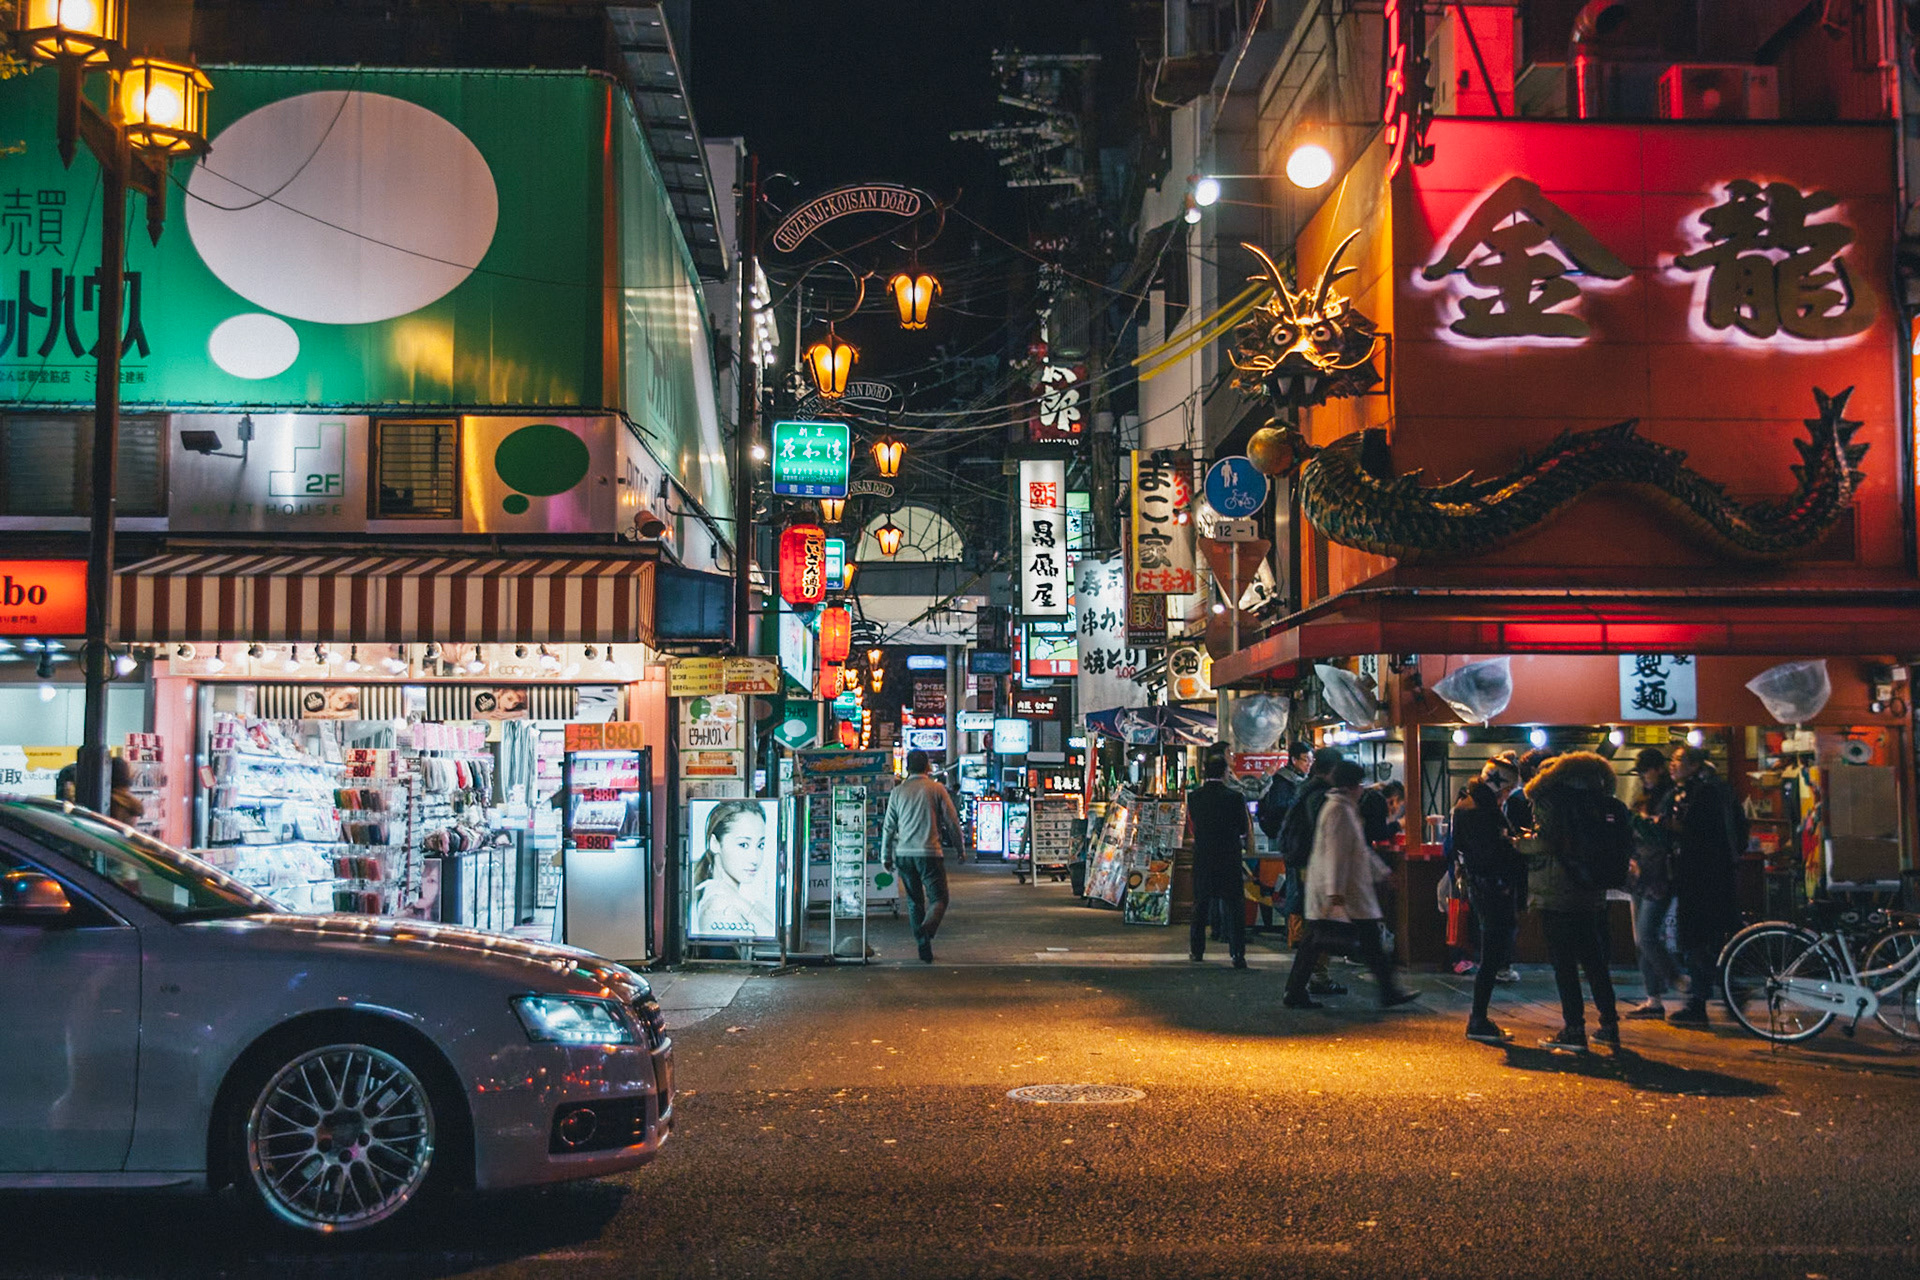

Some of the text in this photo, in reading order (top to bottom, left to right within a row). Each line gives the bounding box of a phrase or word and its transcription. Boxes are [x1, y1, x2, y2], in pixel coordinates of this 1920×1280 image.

[2, 188, 66, 256] 売買
[306, 474, 340, 493] 2F
[266, 503, 342, 516] HOUSE
[1218, 525, 1232, 537] 12
[1136, 568, 1197, 593] はなれ
[0, 575, 47, 606] bo
[1083, 647, 1139, 676] 焼とり
[1173, 652, 1199, 675] 酒
[605, 724, 641, 749] 980
[0, 768, 22, 785] 取
[352, 765, 371, 778] 980
[593, 788, 619, 801] 980
[586, 835, 611, 850] 980
[808, 879, 829, 889] ITAT
